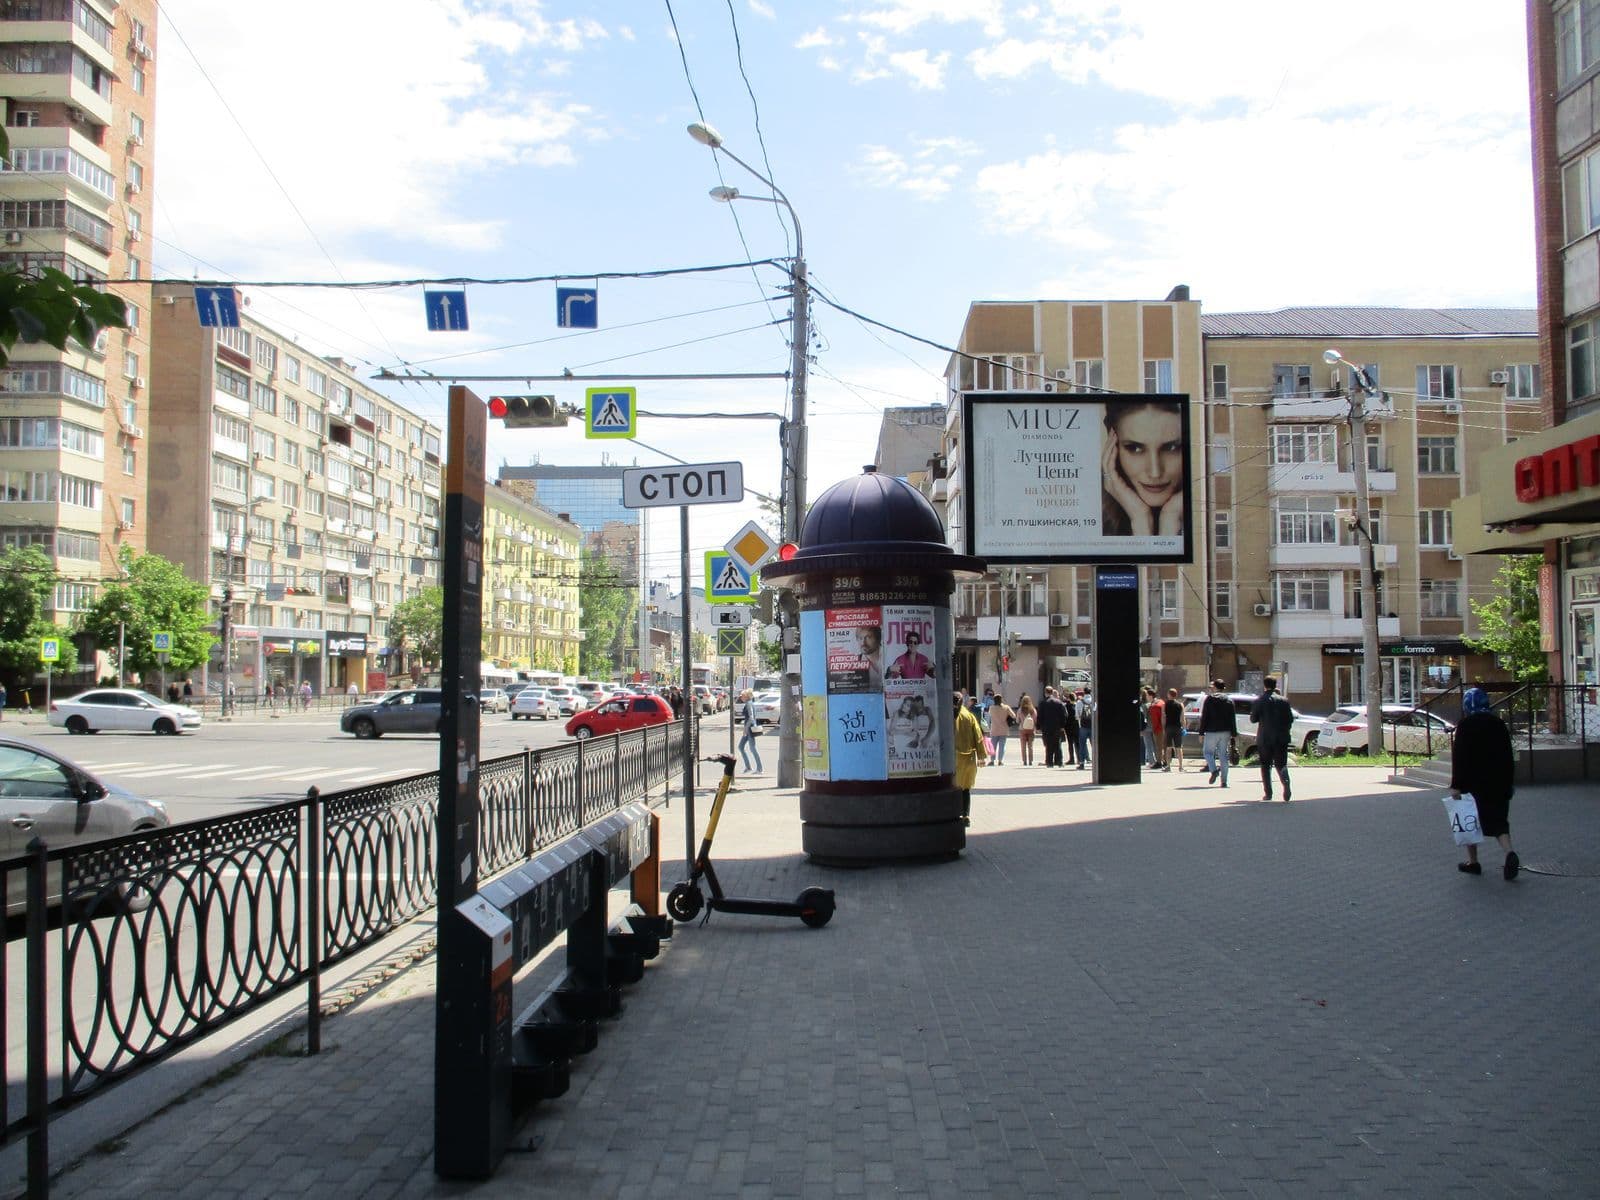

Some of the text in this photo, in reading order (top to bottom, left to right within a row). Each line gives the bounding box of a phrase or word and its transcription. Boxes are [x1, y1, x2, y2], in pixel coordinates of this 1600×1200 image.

[1007, 408, 1081, 430] MIUZ
[1013, 449, 1075, 466] Лучшие
[639, 469, 727, 500] СТОП
[1024, 484, 1076, 495] на ХИТЫ
[1001, 518, 1097, 528] УЛ. ПУШКИНСКАЯ, 119
[834, 576, 861, 589] 39/6
[886, 621, 933, 645] ЛЕПС
[1391, 645, 1435, 654] ecoformica
[830, 661, 870, 670] ПЕТРУХИН
